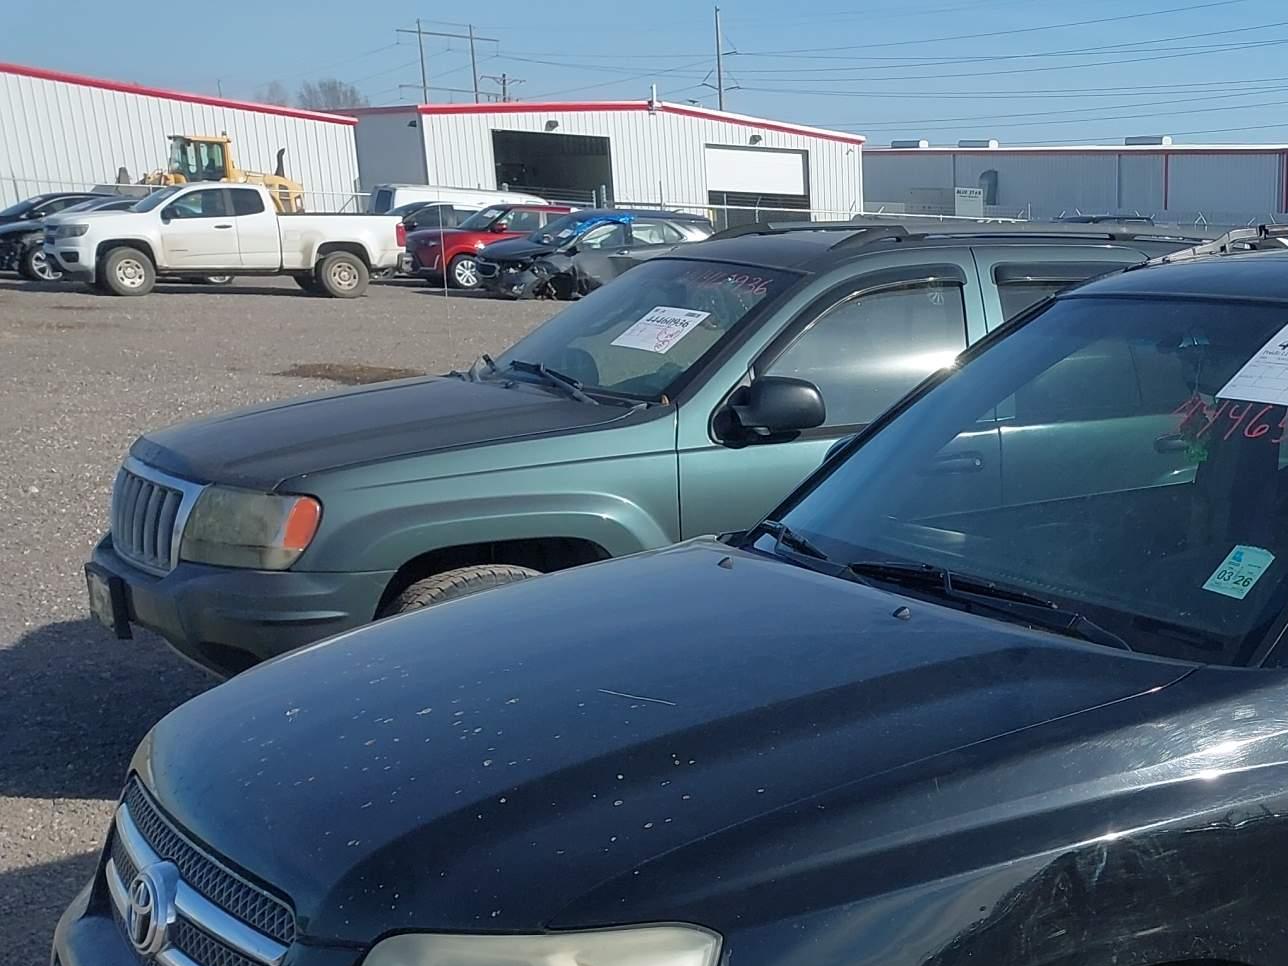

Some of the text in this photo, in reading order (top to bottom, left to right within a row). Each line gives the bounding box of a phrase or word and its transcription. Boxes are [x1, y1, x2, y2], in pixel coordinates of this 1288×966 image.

[645, 315, 690, 329] 44460936
[1216, 569, 1253, 587] 03 26
